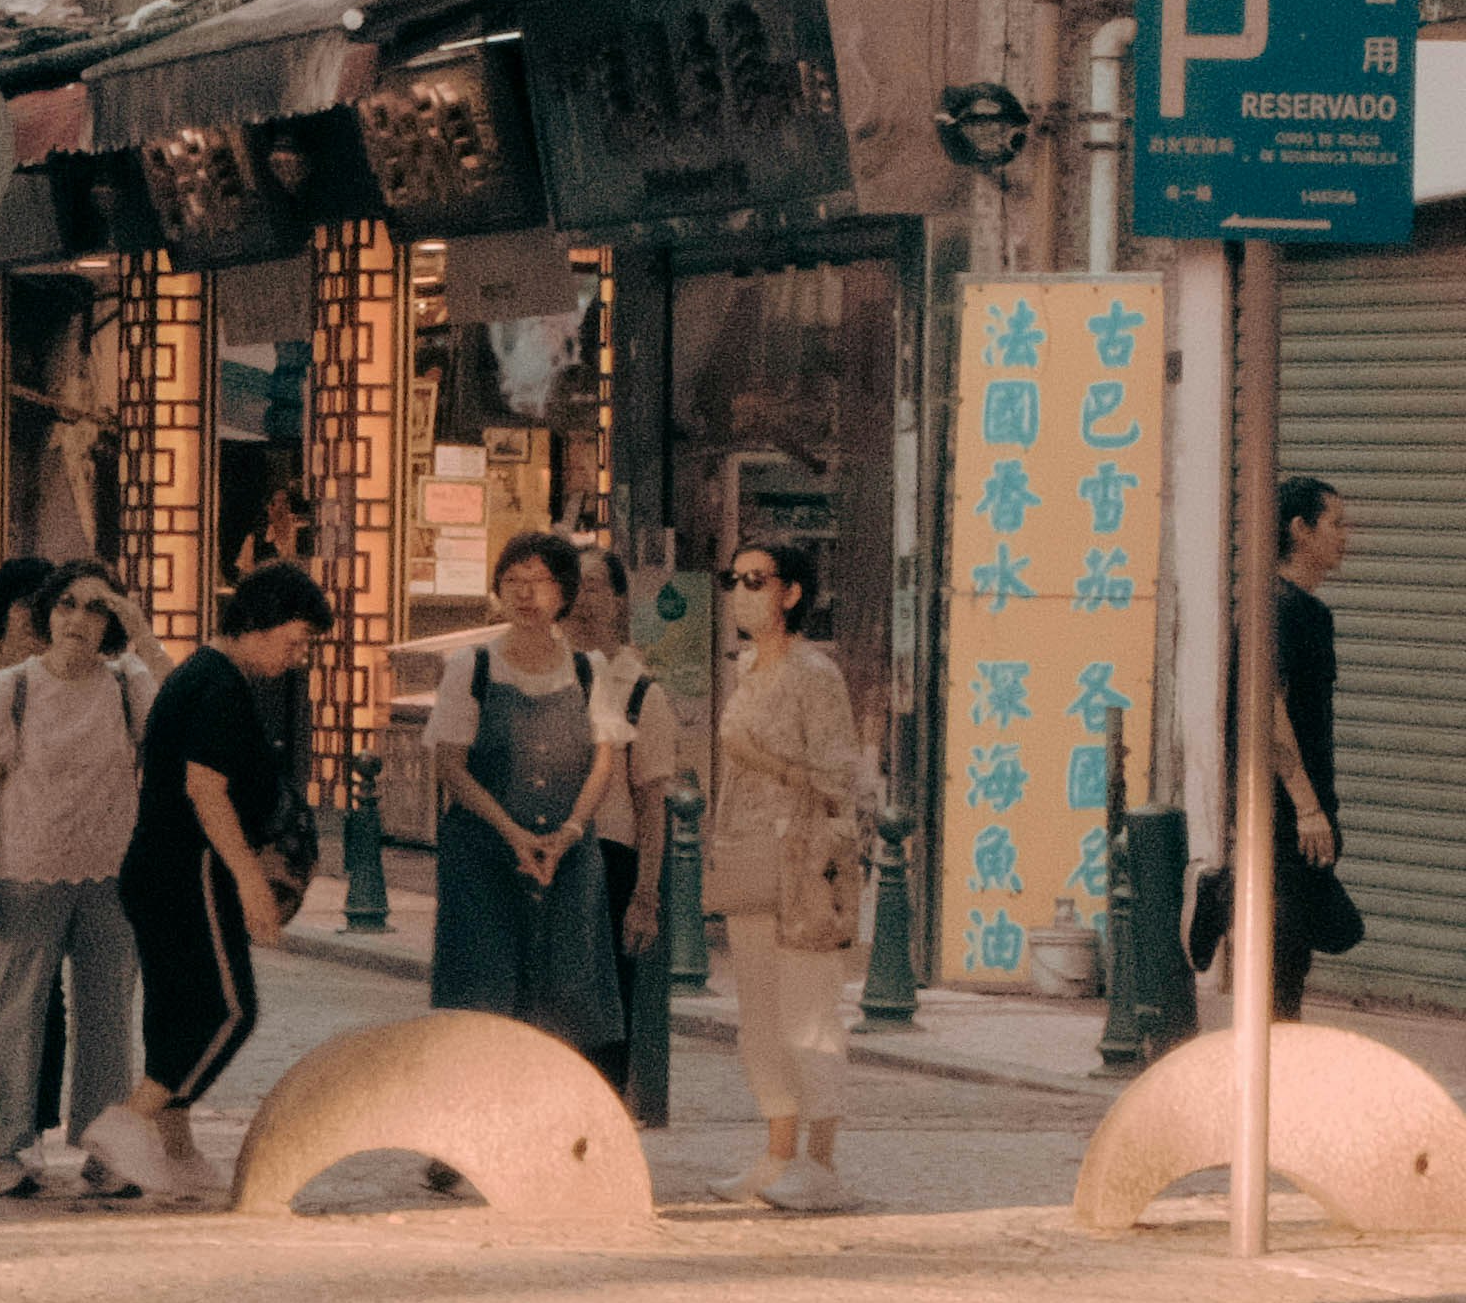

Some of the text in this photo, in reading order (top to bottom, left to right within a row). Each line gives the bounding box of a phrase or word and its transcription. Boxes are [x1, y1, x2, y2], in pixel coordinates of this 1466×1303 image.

[1241, 92, 1398, 121] RESERVADO
[963, 297, 1048, 972] 法國香水 深海魚油
[1066, 661, 1134, 943] 各國名
